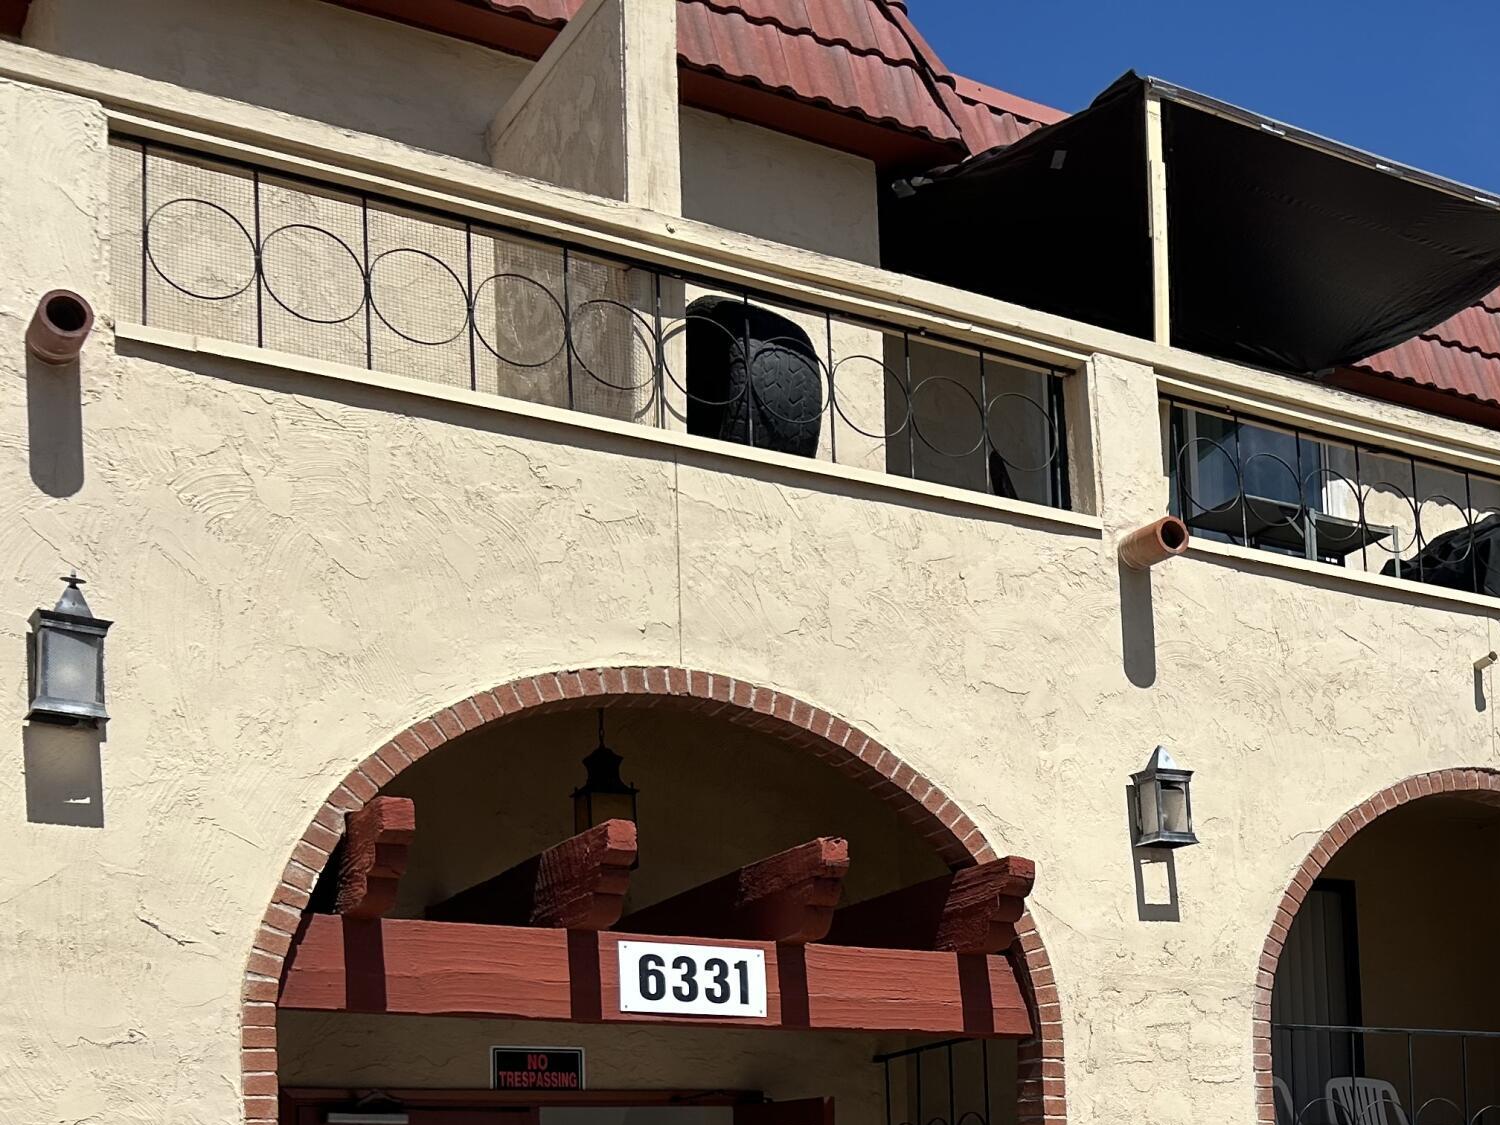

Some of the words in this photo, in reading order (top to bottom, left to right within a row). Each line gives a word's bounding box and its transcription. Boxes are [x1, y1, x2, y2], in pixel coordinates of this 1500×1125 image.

[638, 953, 750, 1005] 6331
[527, 1053, 549, 1071] NO
[498, 1071, 578, 1088] TRESPASSING
